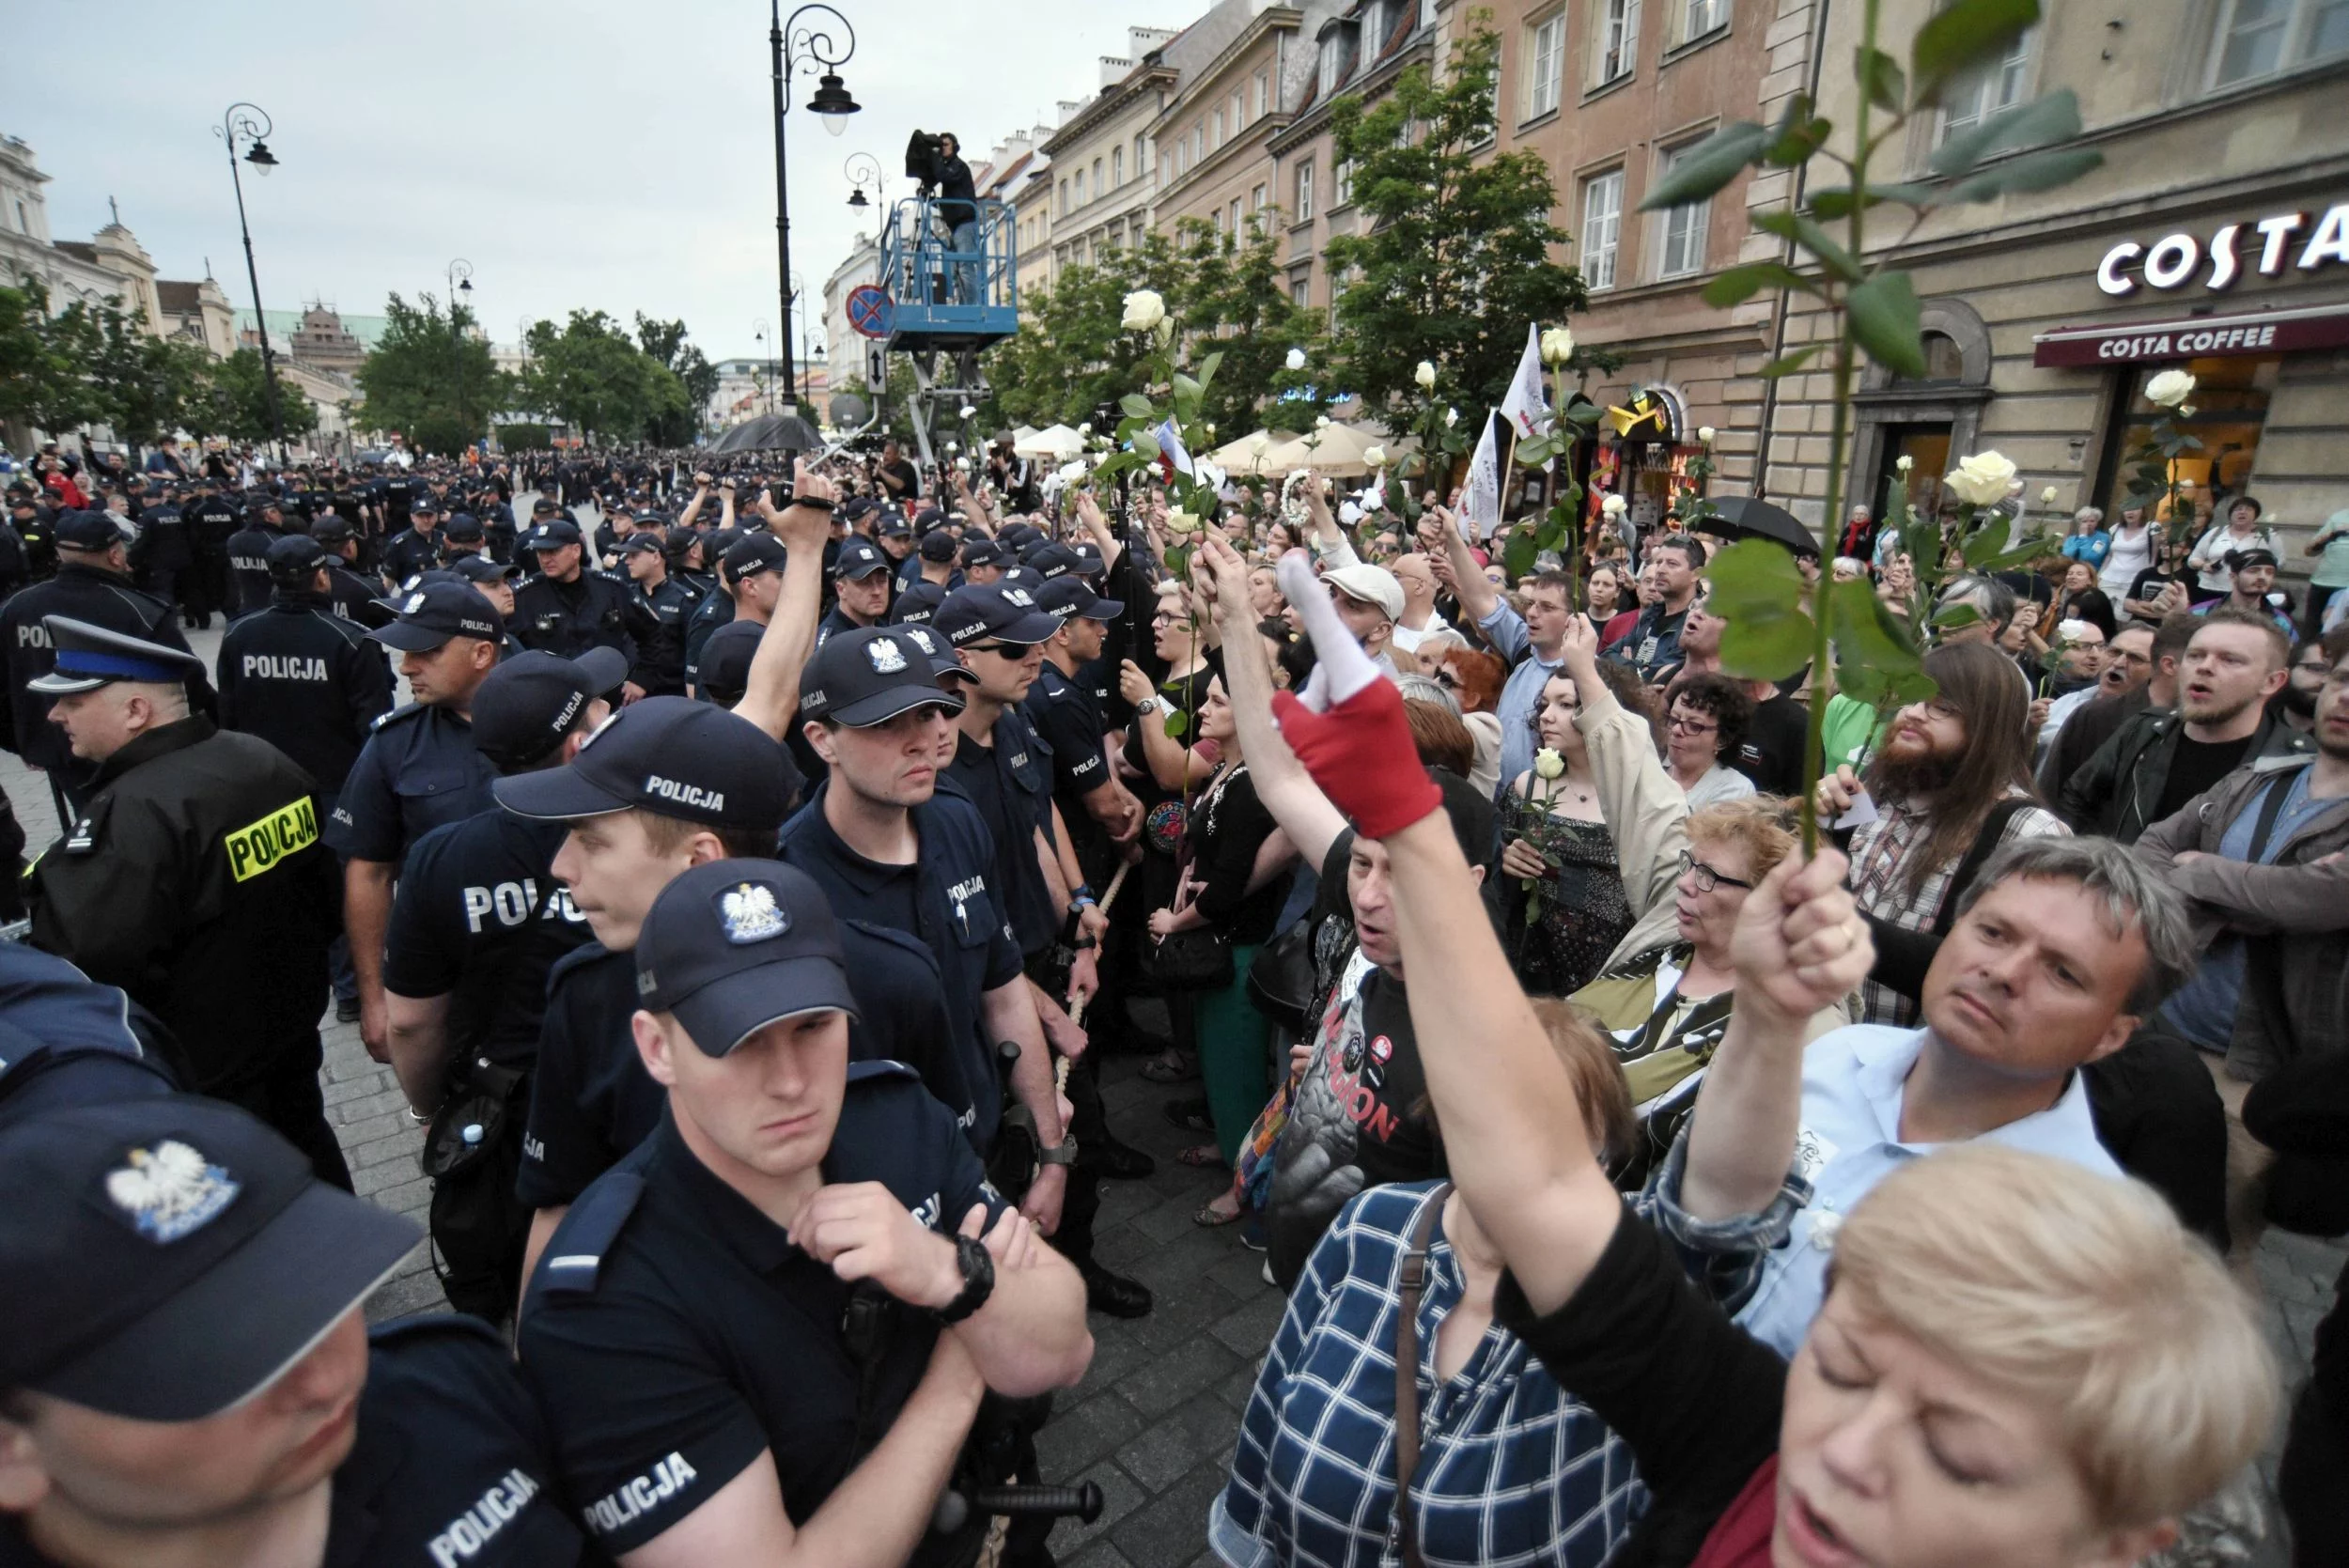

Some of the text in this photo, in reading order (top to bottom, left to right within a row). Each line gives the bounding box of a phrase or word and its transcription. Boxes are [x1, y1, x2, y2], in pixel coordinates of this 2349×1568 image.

[2097, 204, 2349, 295] COSTA
[2099, 325, 2278, 359] COSTA COFFEE
[737, 557, 764, 575] POLICJA
[460, 617, 493, 634] POLICJA
[903, 611, 930, 623] POLICJA
[951, 621, 987, 643] POLICJA
[243, 655, 328, 681] POLICJA
[552, 691, 584, 733] POLICJA
[646, 775, 725, 812] POLICJA
[228, 803, 318, 877] POLICJA
[947, 874, 986, 905] POLICJA
[583, 1451, 698, 1536] POLICJA
[428, 1467, 540, 1568] POLICJA
